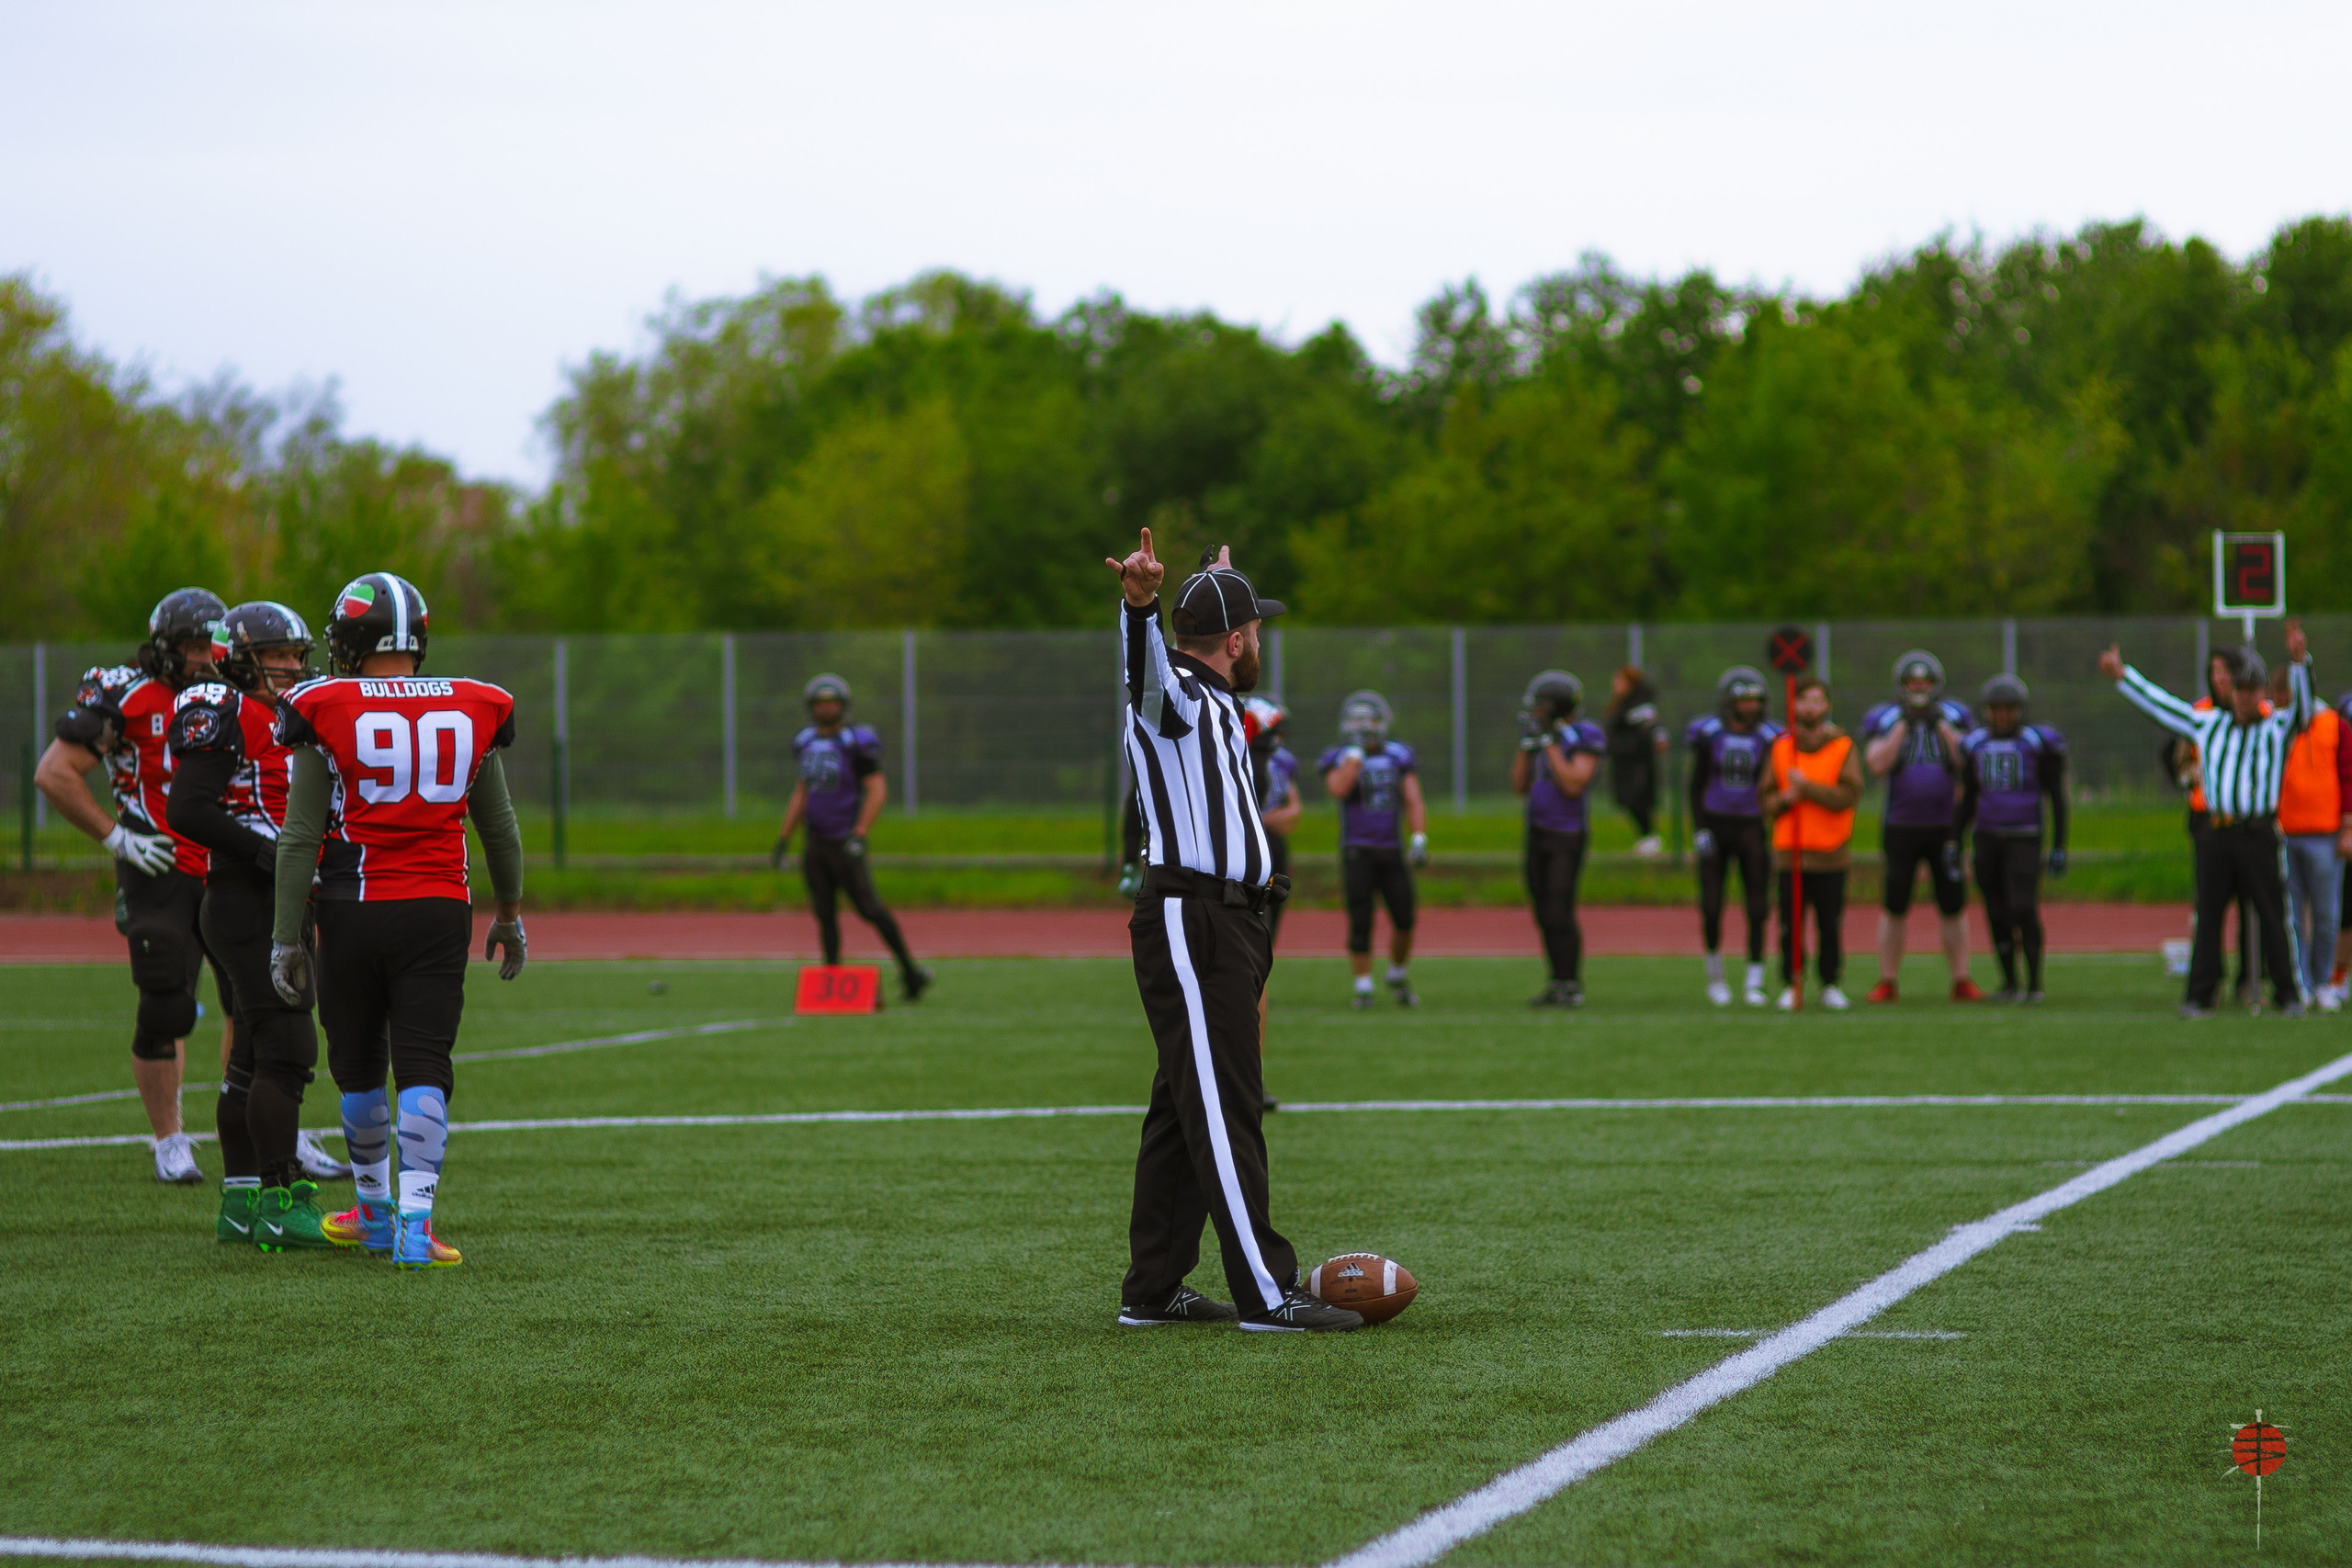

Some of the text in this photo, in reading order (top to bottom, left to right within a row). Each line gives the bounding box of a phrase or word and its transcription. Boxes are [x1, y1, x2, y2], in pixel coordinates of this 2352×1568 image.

[2239, 544, 2271, 600] 2
[359, 681, 455, 698] BULLDOGS
[355, 709, 475, 805] 90
[813, 973, 860, 1002] 30
